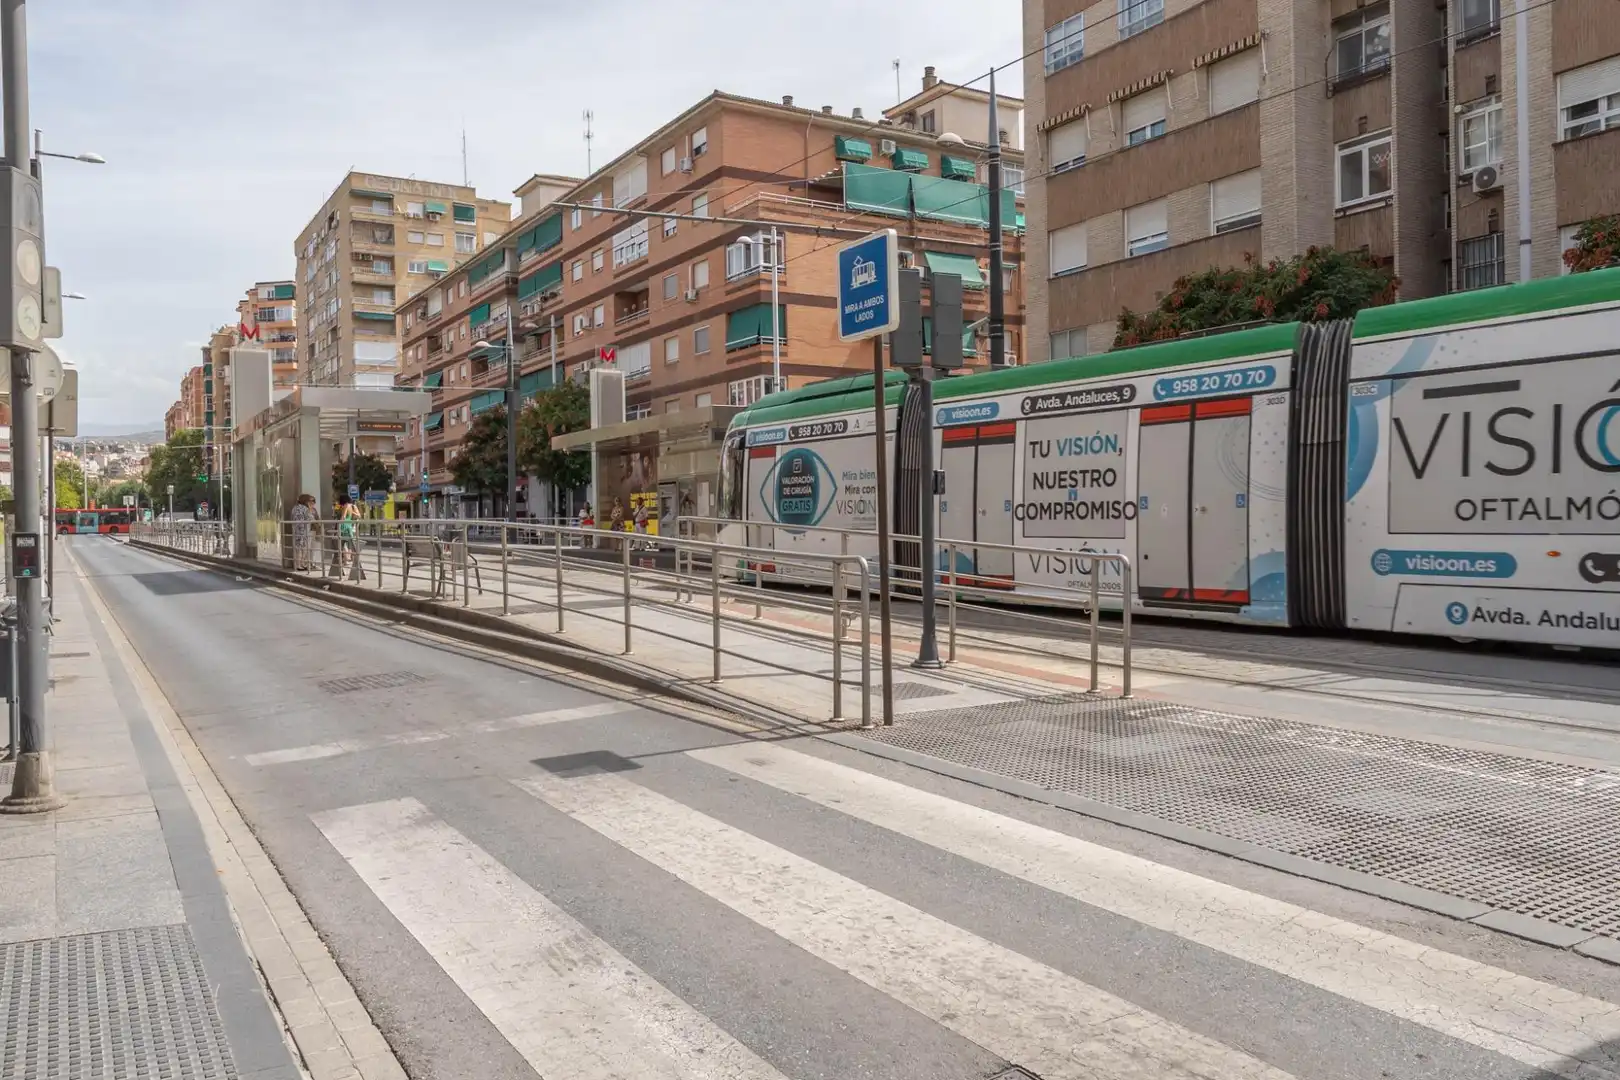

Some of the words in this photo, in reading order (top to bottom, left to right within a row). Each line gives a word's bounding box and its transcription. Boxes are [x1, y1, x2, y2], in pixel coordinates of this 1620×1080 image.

[844, 303, 858, 314] MIRA
[858, 301, 863, 309] A
[863, 295, 885, 307] AMBOS
[855, 311, 873, 323] LADOS
[241, 324, 260, 340] M
[600, 347, 616, 362] M
[1173, 379, 1198, 393] 958
[1201, 376, 1220, 390] 20
[1224, 373, 1242, 388] 70
[1247, 370, 1266, 384] 70
[1036, 397, 1062, 409] Avda.
[1064, 390, 1120, 406] Andaluces,
[1123, 388, 1131, 399] 9
[952, 407, 991, 419] visioon.es
[798, 426, 811, 436] 958
[812, 425, 822, 435] 20
[823, 424, 832, 434] 70
[834, 422, 844, 432] 70
[1029, 440, 1050, 459] TU
[1056, 431, 1123, 457] VISIÓN,
[782, 474, 814, 485] VALORACIÓN
[842, 471, 857, 480] Mira
[1032, 468, 1116, 490] NUESTRO
[783, 487, 790, 495] DE
[791, 485, 812, 494] CIRUGÍA
[845, 485, 860, 495] Mira
[783, 500, 811, 512] GRATIS
[1014, 500, 1137, 521] COMPROMISO
[1406, 554, 1496, 572] visioon.es
[1472, 606, 1530, 626] Avda.
[1538, 610, 1620, 631] Andalu
